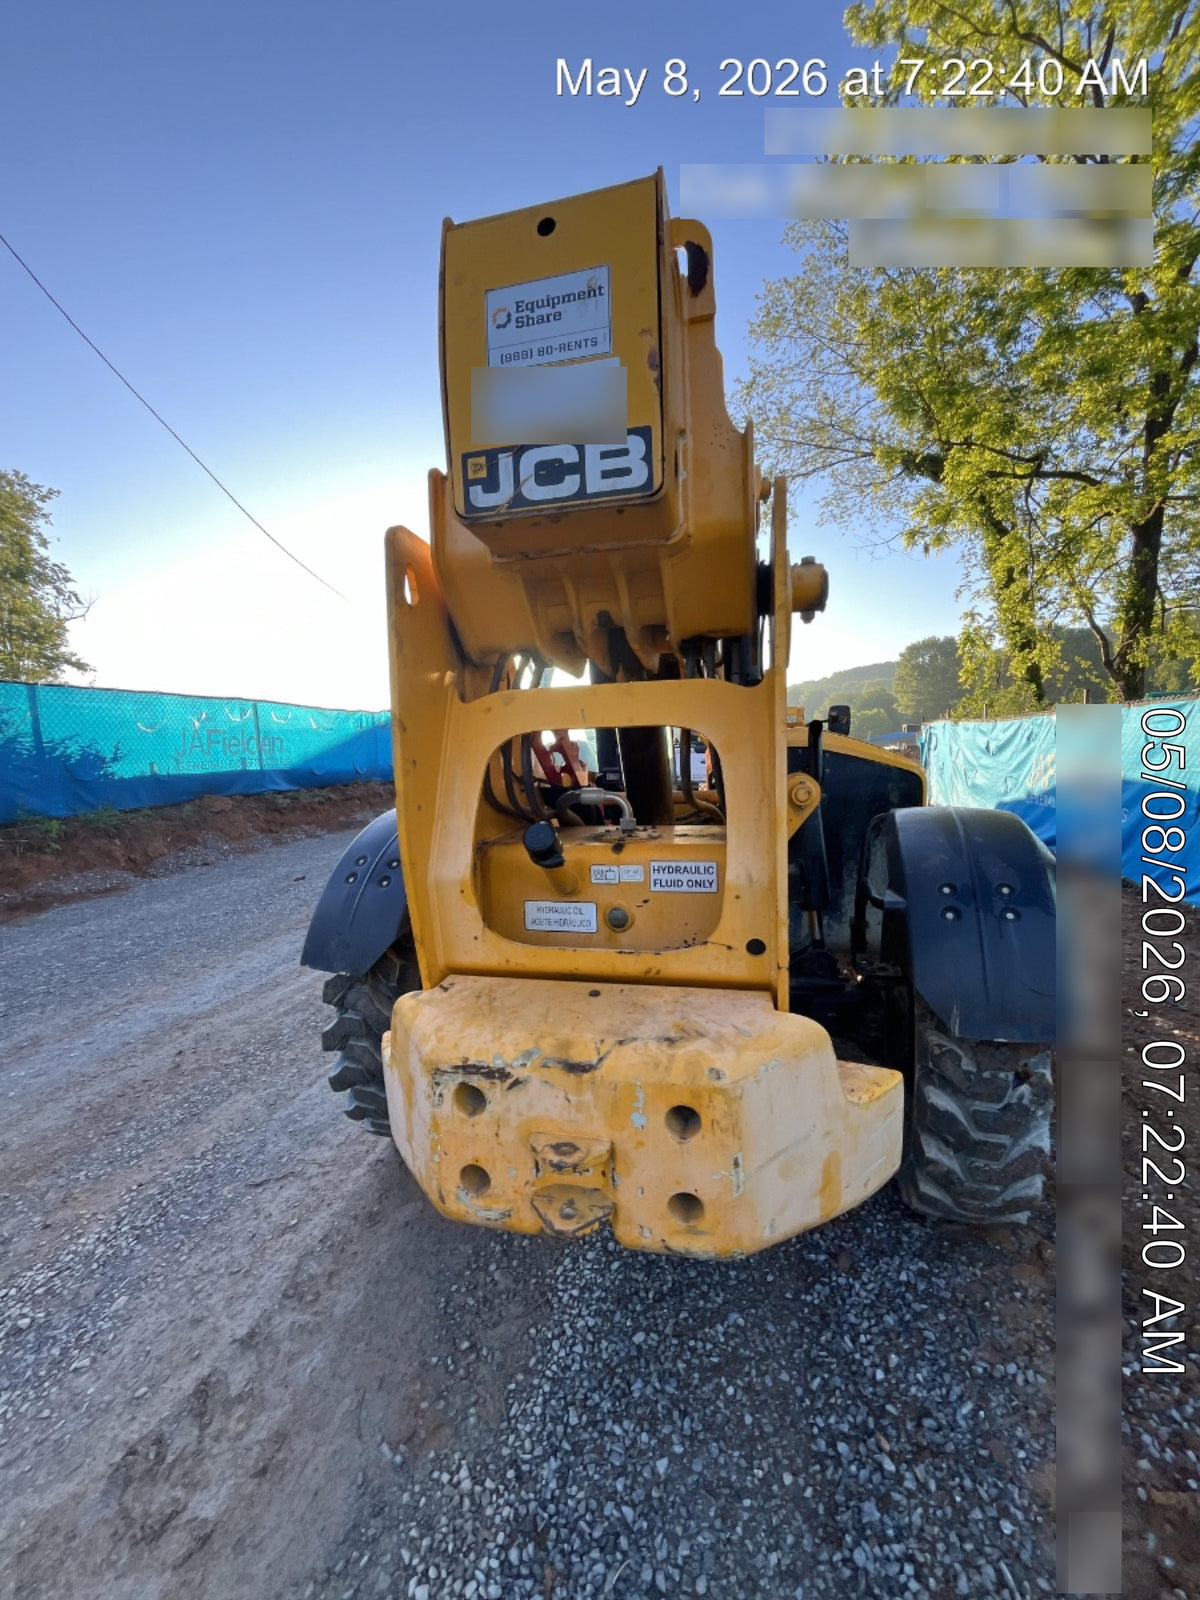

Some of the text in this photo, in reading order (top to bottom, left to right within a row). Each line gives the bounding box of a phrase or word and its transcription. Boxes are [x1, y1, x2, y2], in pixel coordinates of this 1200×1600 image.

[514, 283, 605, 314] Equipment
[515, 311, 562, 329] Share
[500, 337, 598, 365] (888) 80-RENTS
[469, 434, 649, 508] JCB
[652, 865, 715, 876] HYDRAULIC
[653, 879, 715, 889] FLUID ONLY
